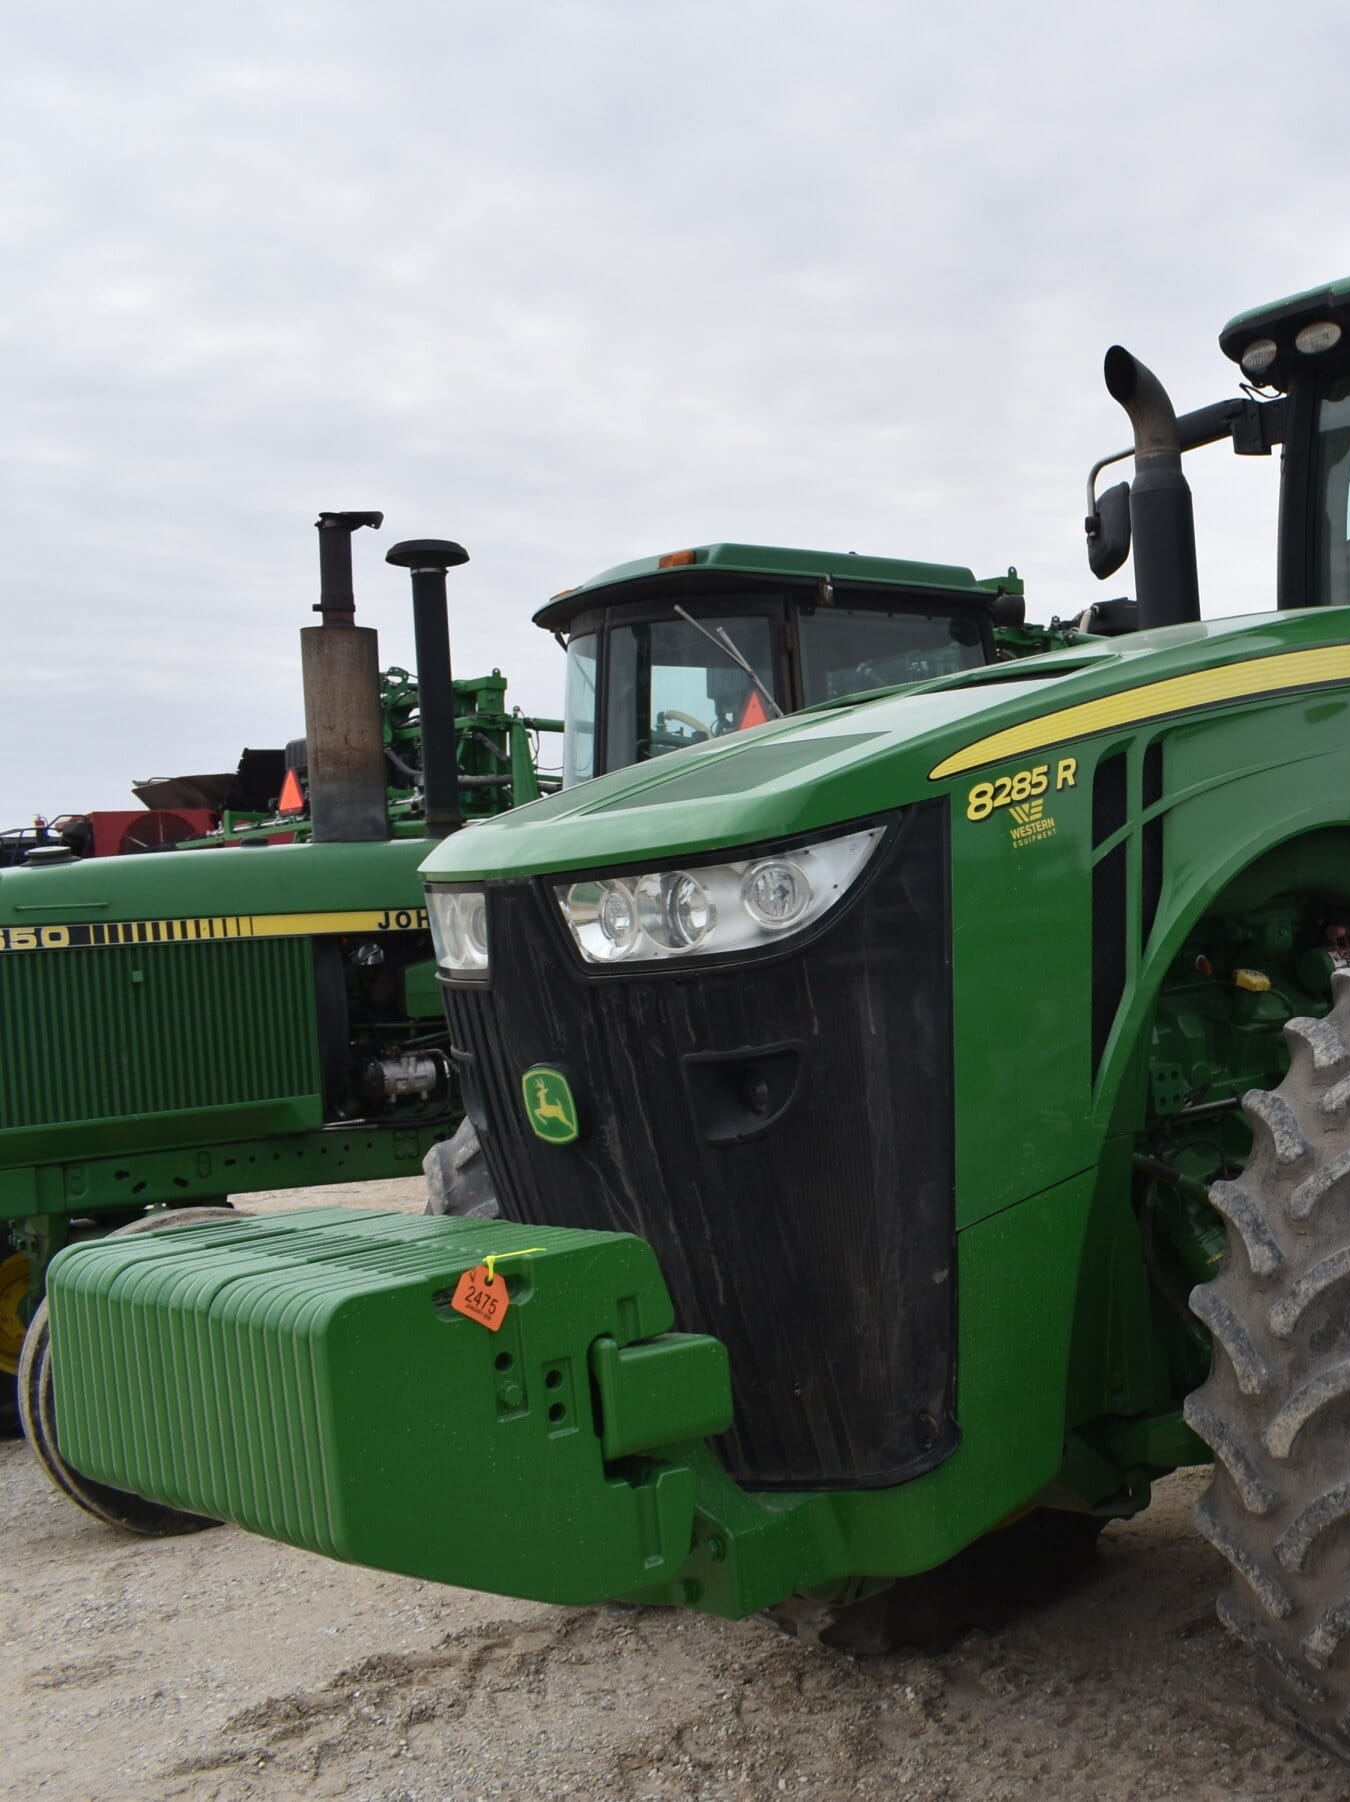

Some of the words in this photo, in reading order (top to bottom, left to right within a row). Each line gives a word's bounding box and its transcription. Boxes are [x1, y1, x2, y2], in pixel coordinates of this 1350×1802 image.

[967, 764, 1048, 821] 8285
[1056, 757, 1077, 790] R
[1010, 817, 1055, 840] WESTERN
[1012, 828, 1057, 849] EQUIPMENT
[377, 910, 432, 930] JOH
[0, 925, 70, 951] 50
[465, 1286, 498, 1316] 2475
